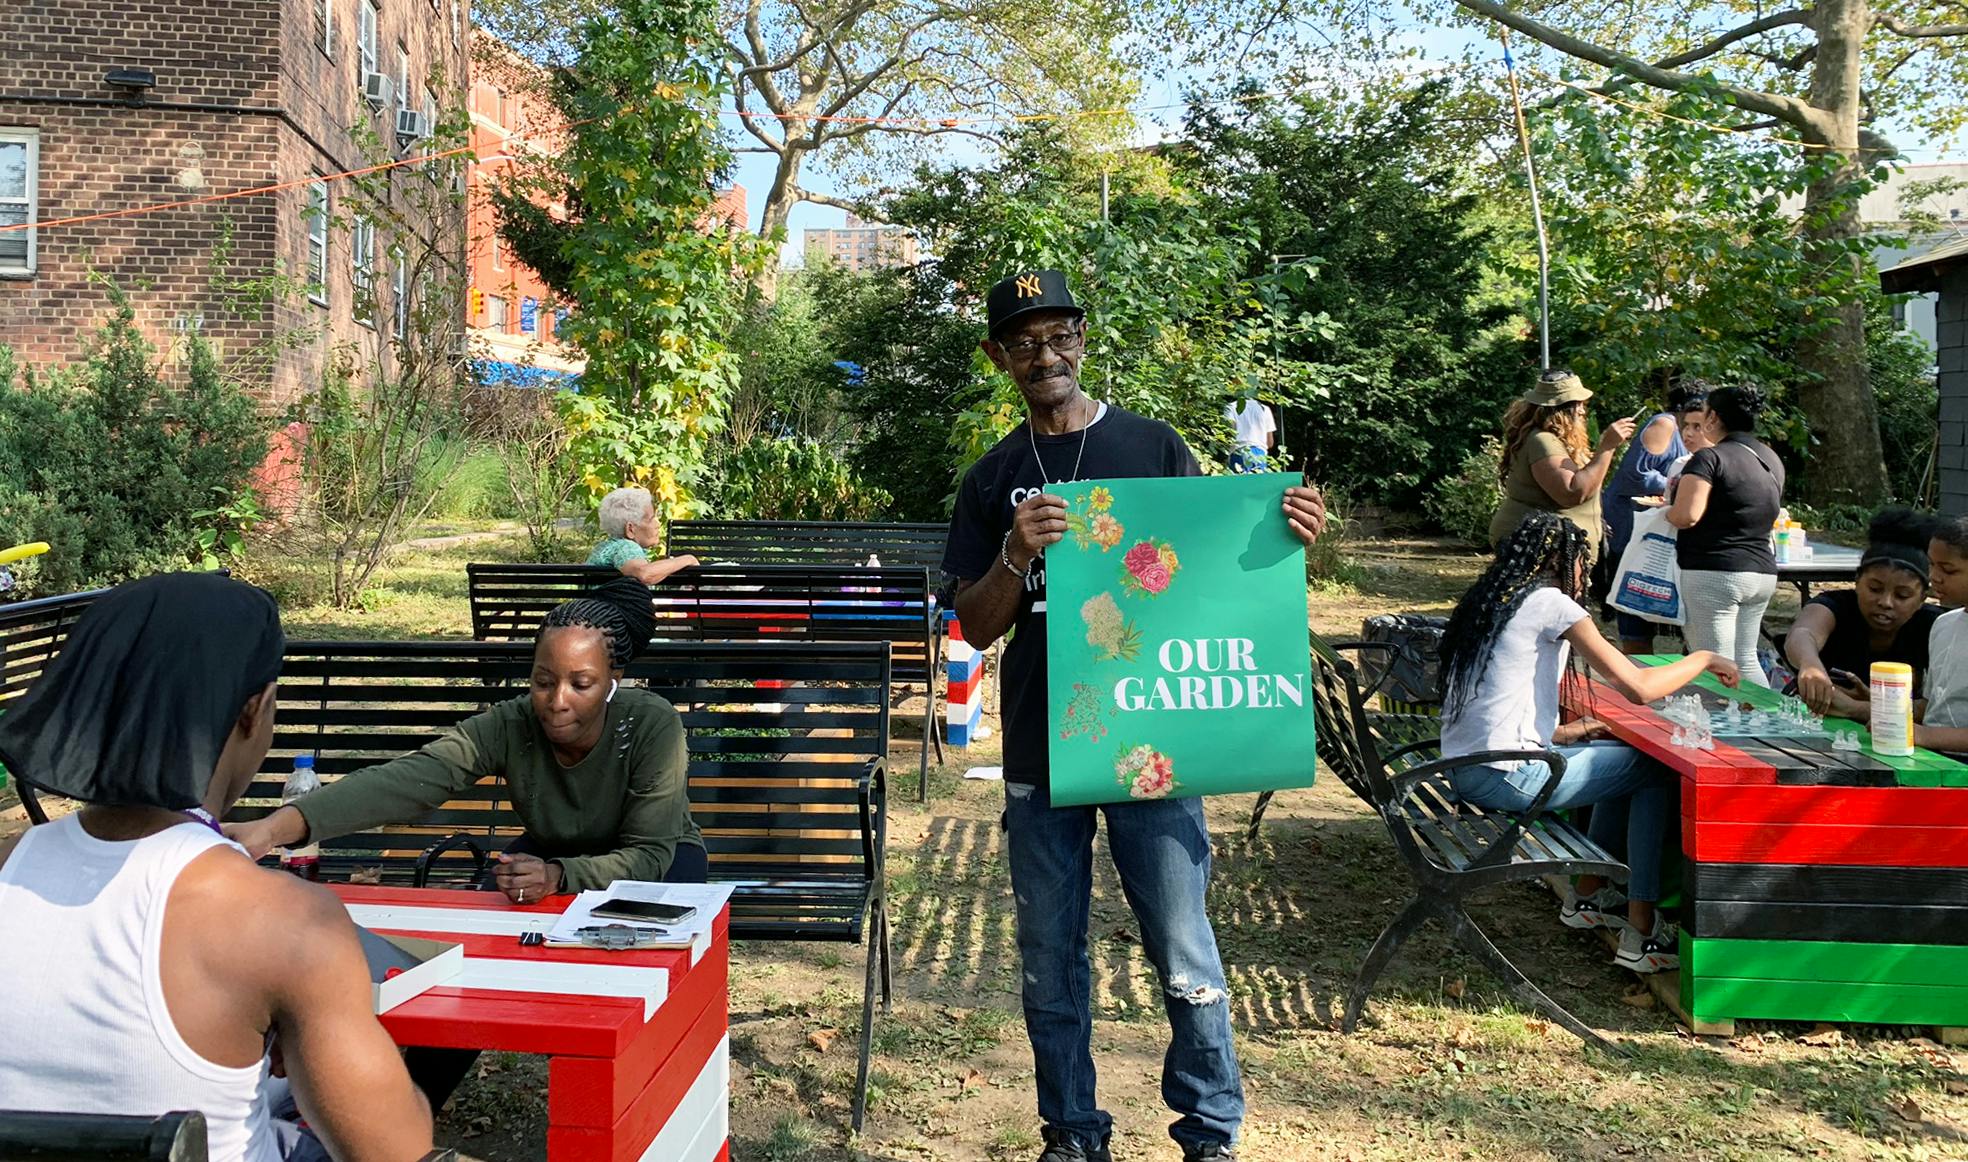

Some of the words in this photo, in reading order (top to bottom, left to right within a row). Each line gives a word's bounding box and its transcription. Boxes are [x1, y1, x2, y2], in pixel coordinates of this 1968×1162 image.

[1015, 273, 1043, 298] NY
[1158, 638, 1258, 673] OUR
[1113, 673, 1304, 712] GARDEN
